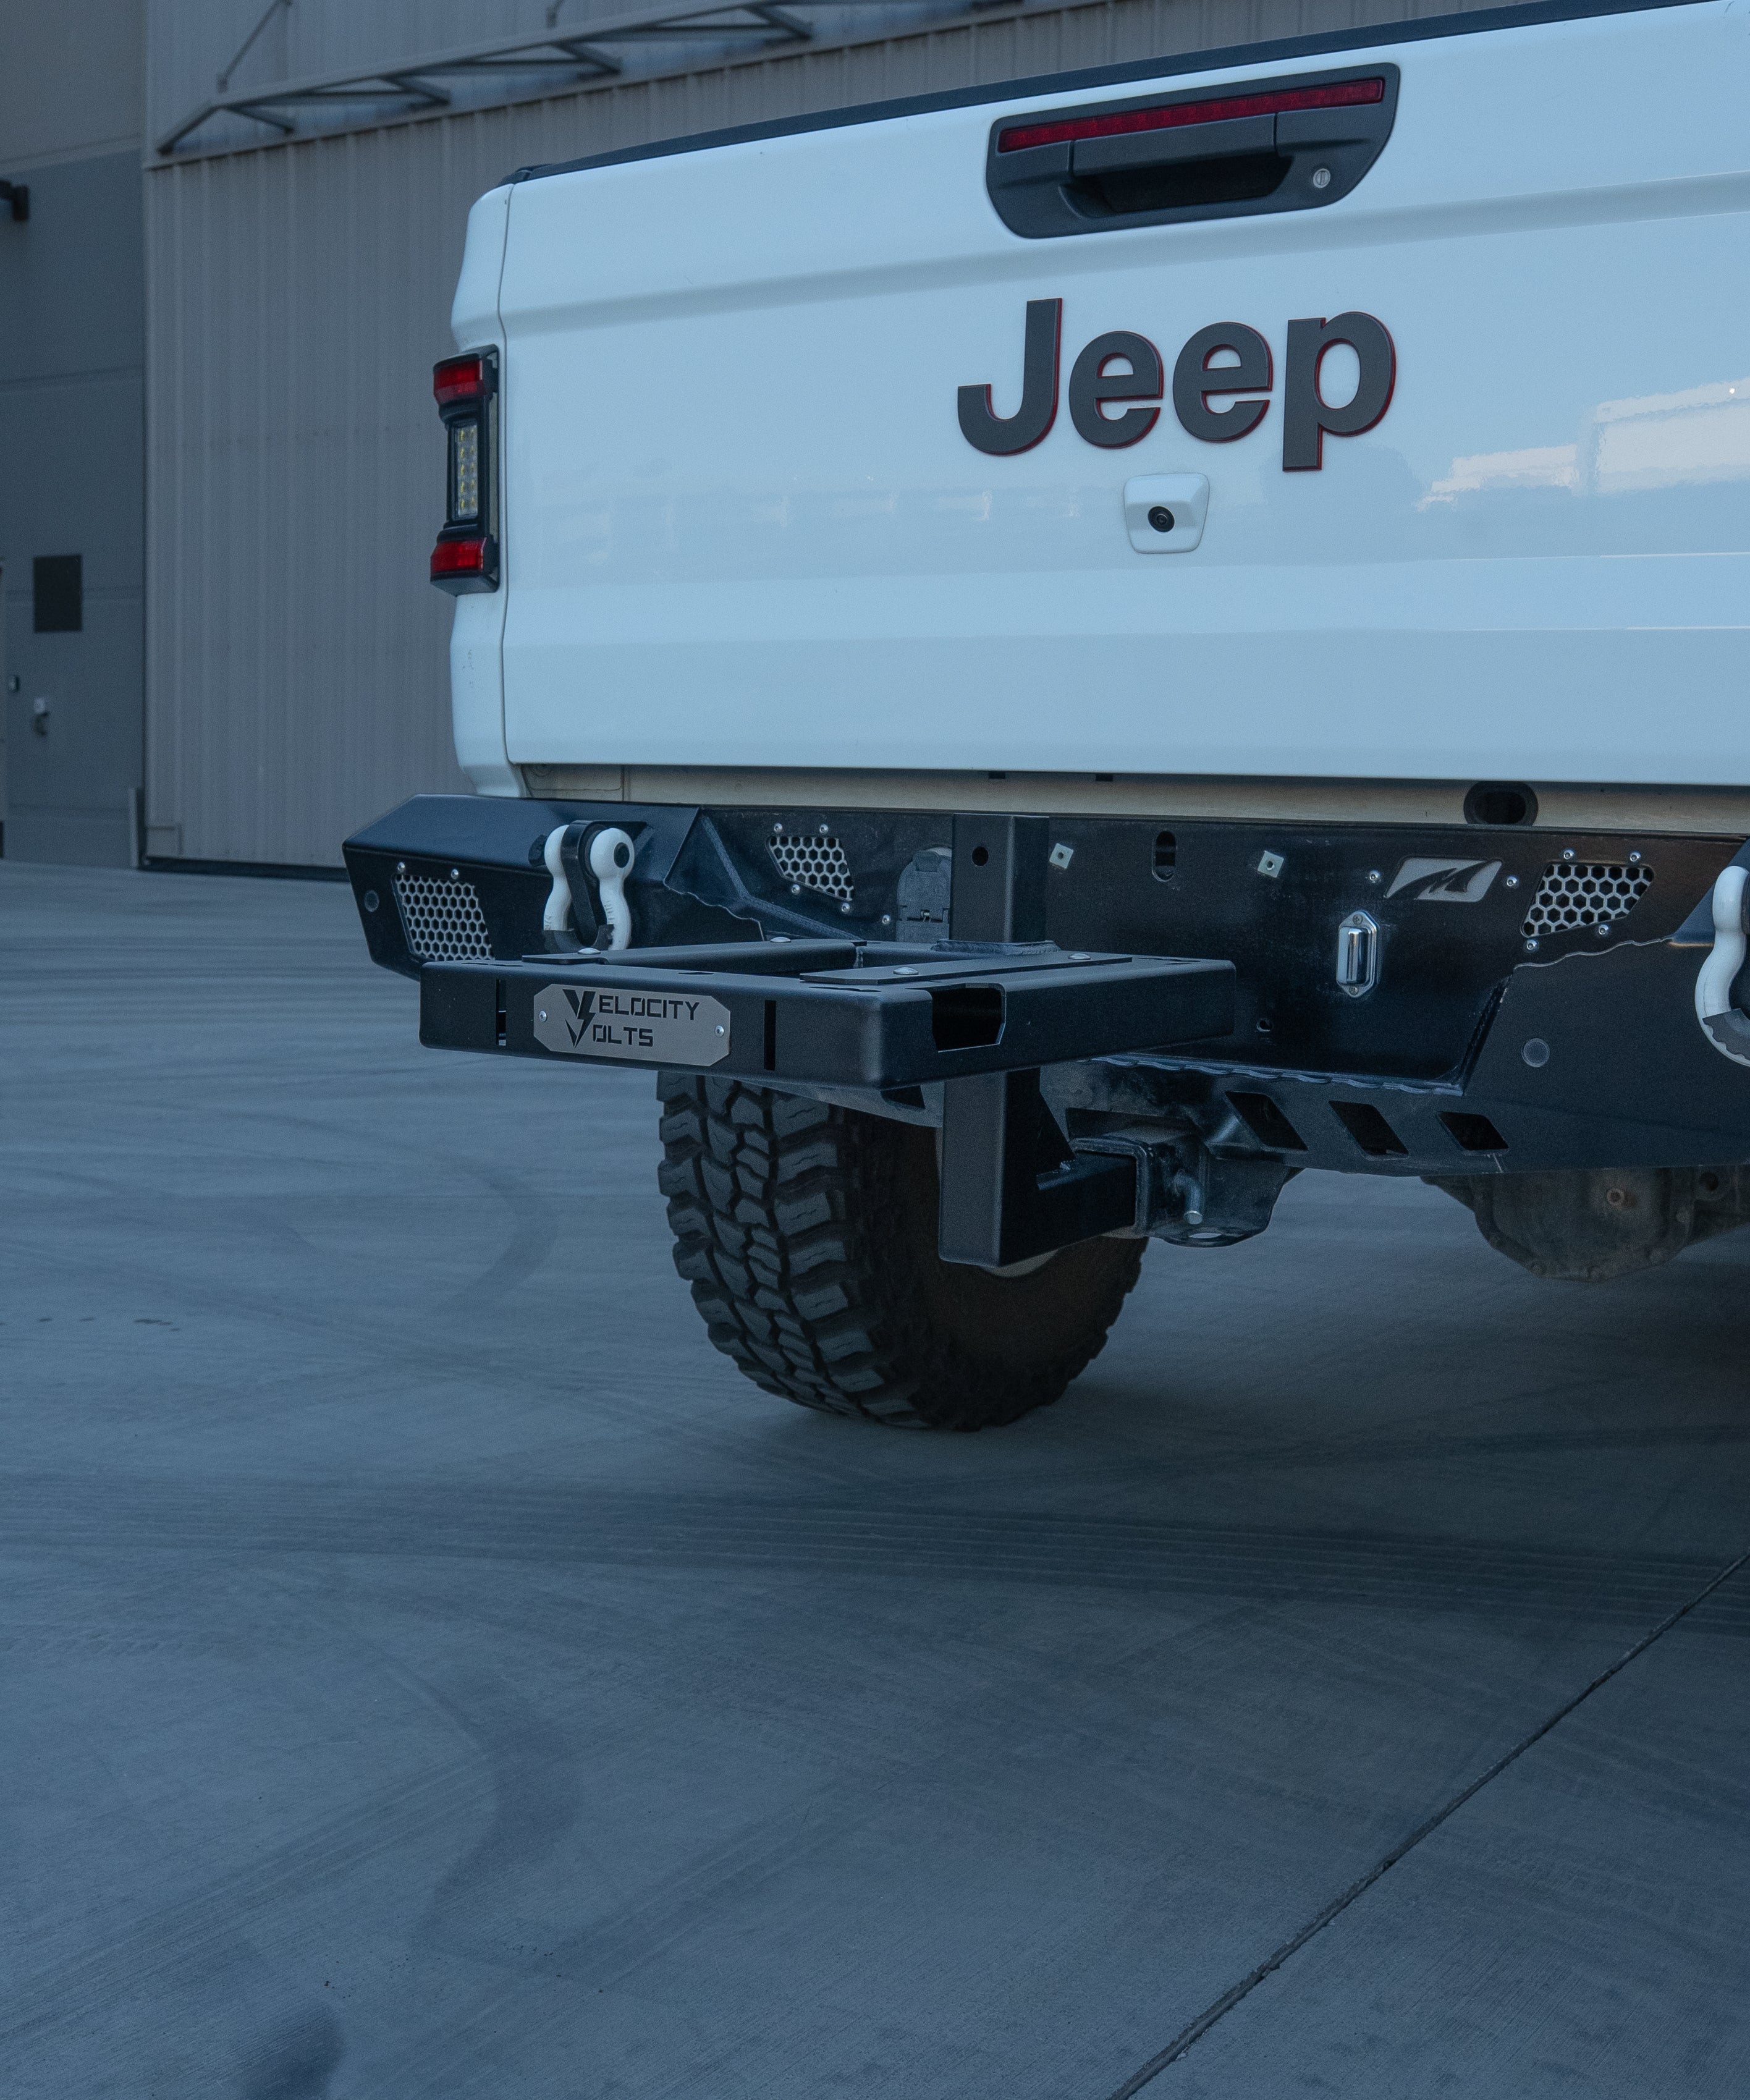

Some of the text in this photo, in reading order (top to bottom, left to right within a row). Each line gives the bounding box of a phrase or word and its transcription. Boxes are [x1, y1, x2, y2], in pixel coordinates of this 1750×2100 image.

[957, 297, 1397, 472] Jeep
[562, 988, 700, 1020] VELOCITY
[565, 1013, 653, 1048] VOLTS
